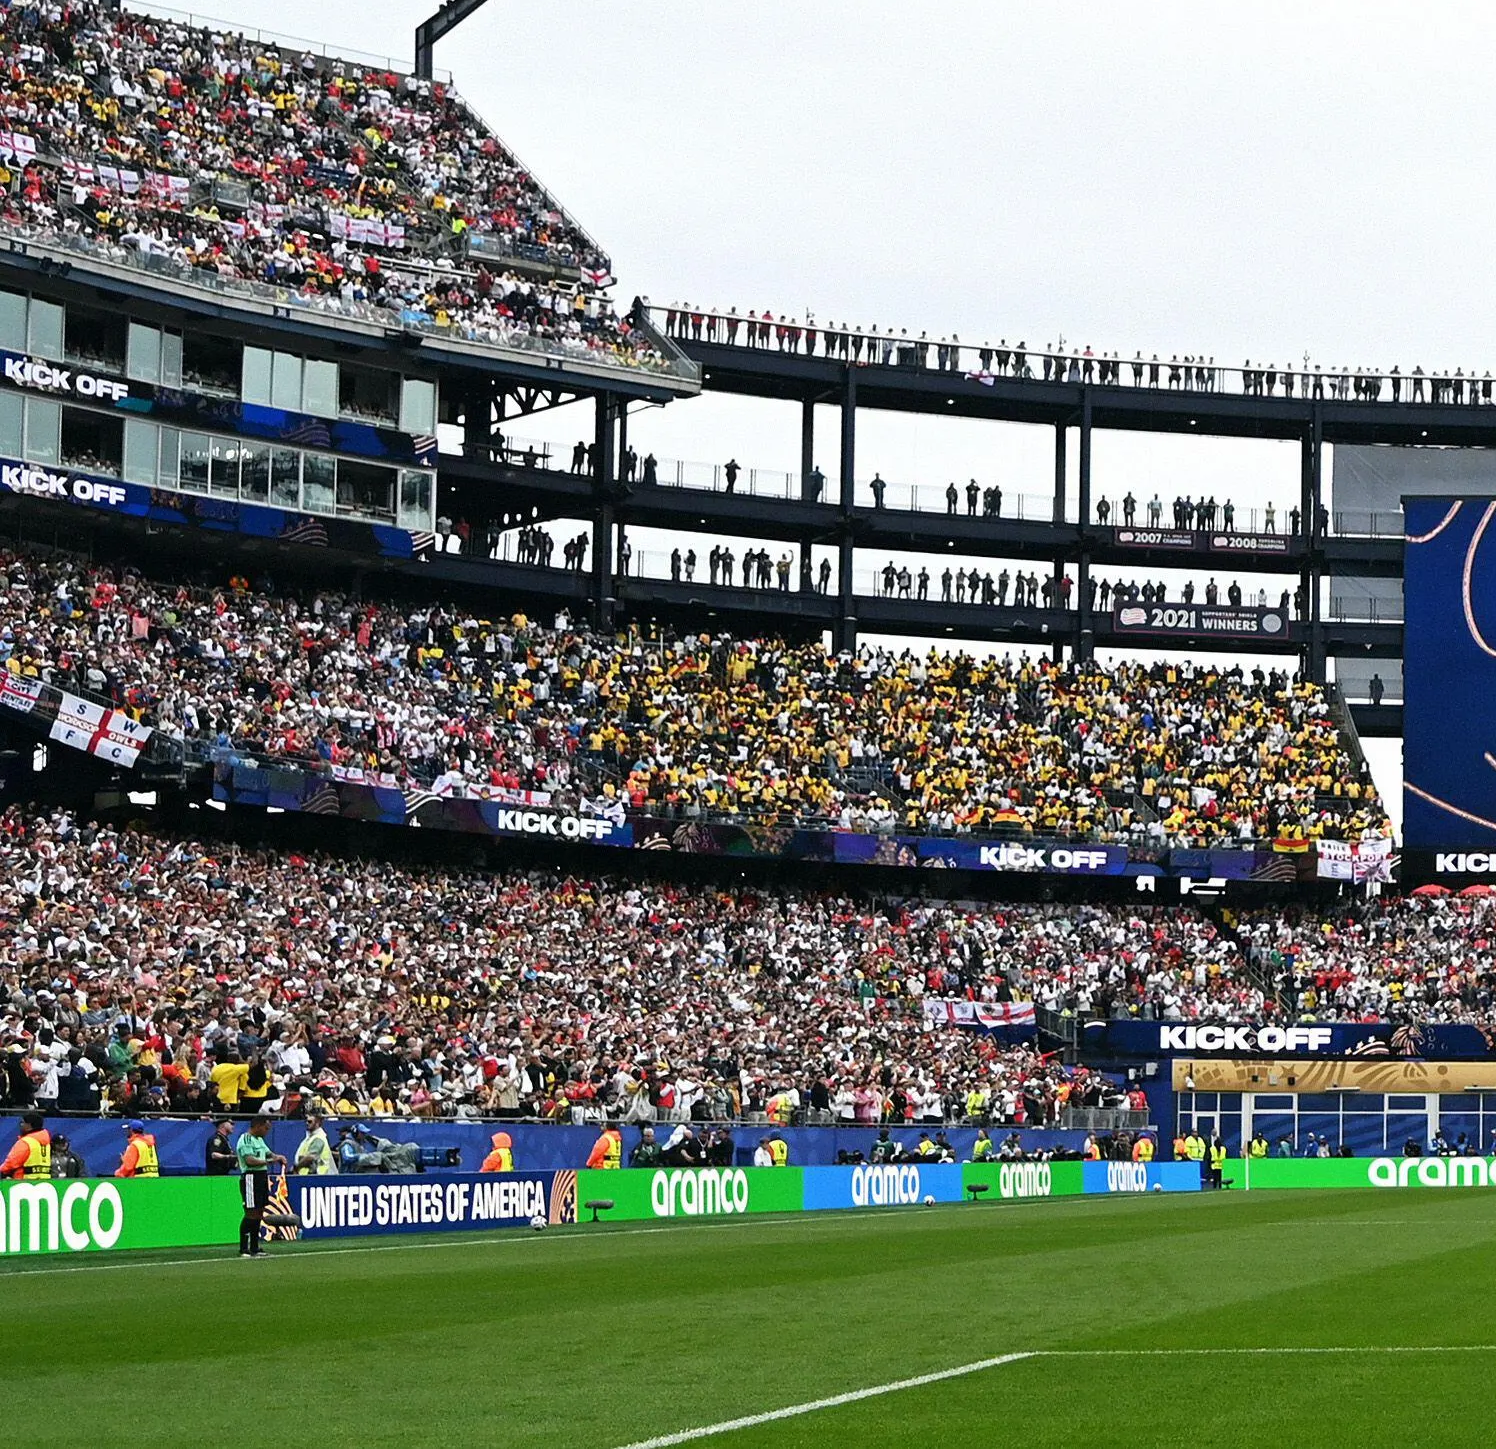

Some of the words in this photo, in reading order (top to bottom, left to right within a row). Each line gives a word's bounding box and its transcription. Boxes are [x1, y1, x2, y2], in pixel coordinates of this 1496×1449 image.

[6, 356, 71, 390] KICK
[76, 373, 129, 401] OFF
[2, 464, 69, 496] KICK
[73, 477, 126, 505] OFF
[1134, 532, 1161, 543] 2007
[1229, 537, 1257, 549] 2008
[1152, 608, 1196, 628] 2021
[1202, 618, 1258, 631] WINNERS
[58, 713, 99, 733] WORKSOP
[109, 732, 137, 747] OWLS
[77, 704, 87, 715] S
[124, 721, 138, 733] W
[66, 730, 75, 739] F
[112, 748, 121, 758] C
[498, 809, 558, 835] KICK
[561, 816, 613, 839] OFF
[980, 846, 1046, 868] KICK
[1052, 849, 1107, 869] OFF
[1160, 1026, 1250, 1049] KICK
[1258, 1027, 1332, 1051] OFF
[852, 1165, 919, 1205] aramco
[1000, 1162, 1051, 1197] aramco
[1108, 1161, 1147, 1192] aramco
[301, 1186, 373, 1229] UNITED
[376, 1184, 442, 1224] STATES
[446, 1183, 469, 1222] OF
[471, 1181, 546, 1220] AMERICA
[652, 1169, 748, 1216] aramco
[0, 1182, 123, 1252] mco
